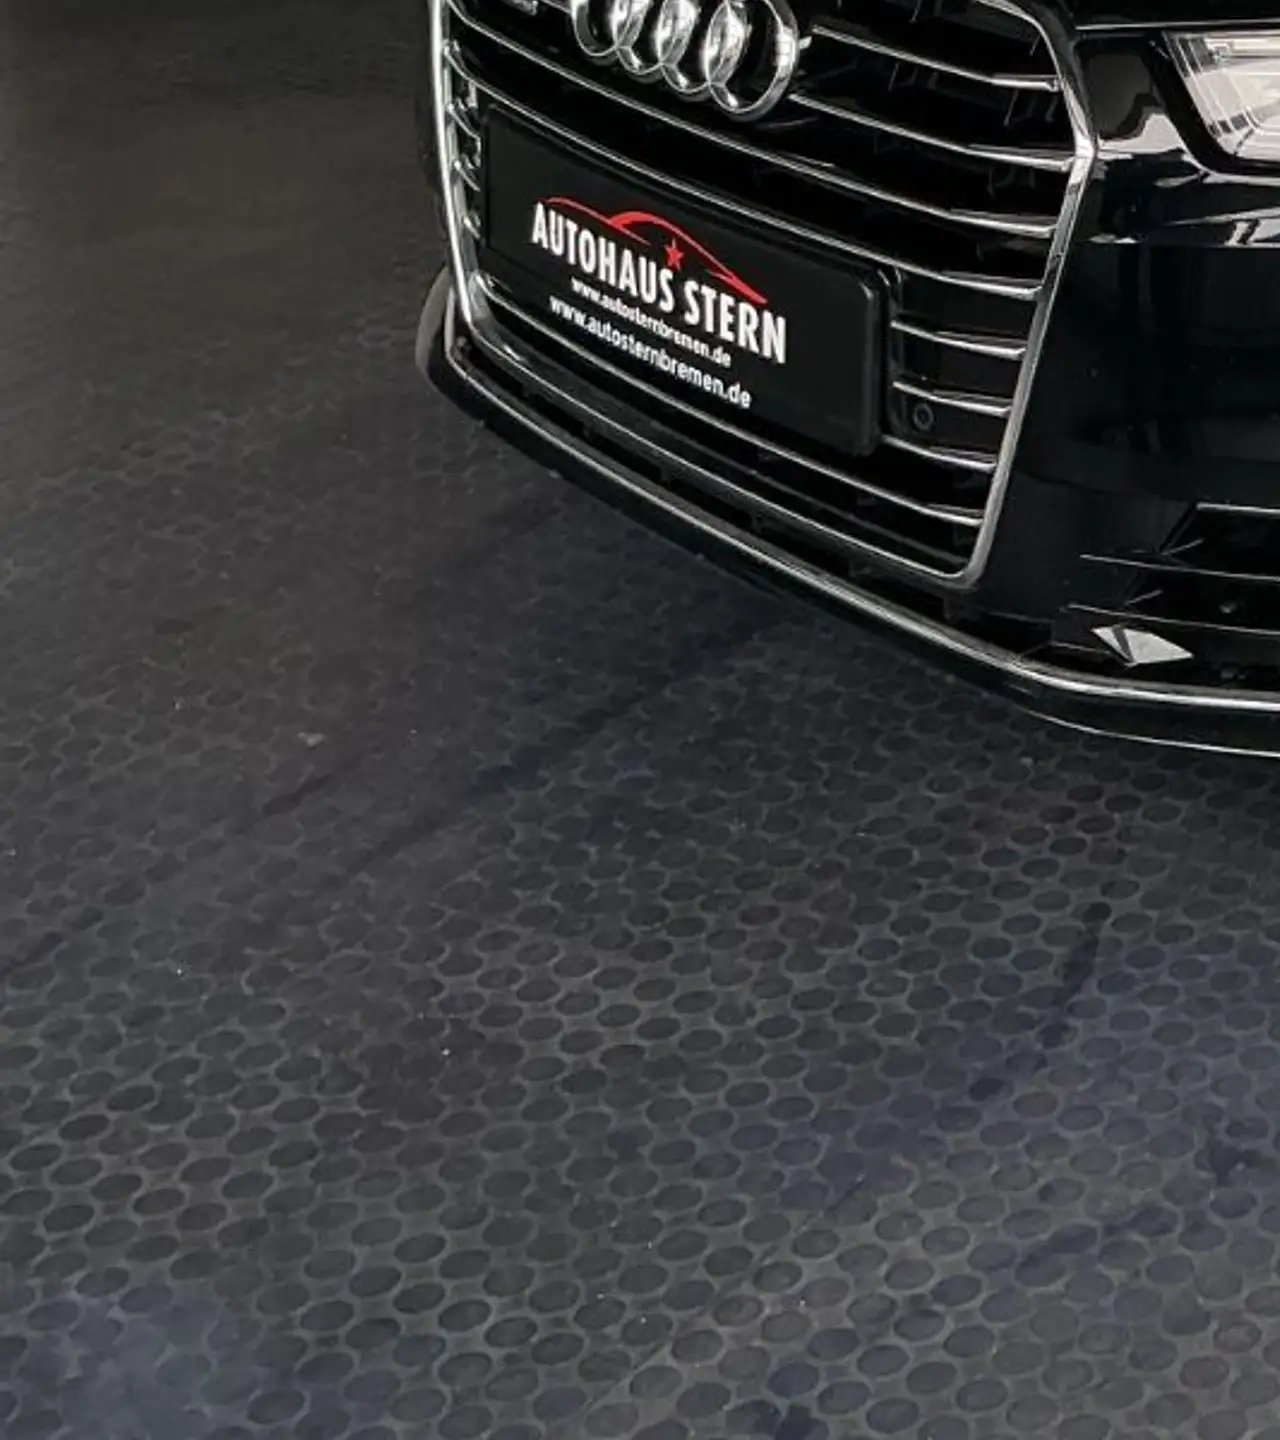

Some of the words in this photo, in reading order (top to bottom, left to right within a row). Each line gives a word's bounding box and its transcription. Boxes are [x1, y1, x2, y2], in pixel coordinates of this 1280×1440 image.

[532, 202, 675, 312] AUTOHAUS
[683, 280, 787, 364] STERN
[571, 276, 732, 368] www.autosternbremen.de
[549, 295, 752, 409] www.autosternbremen.de
